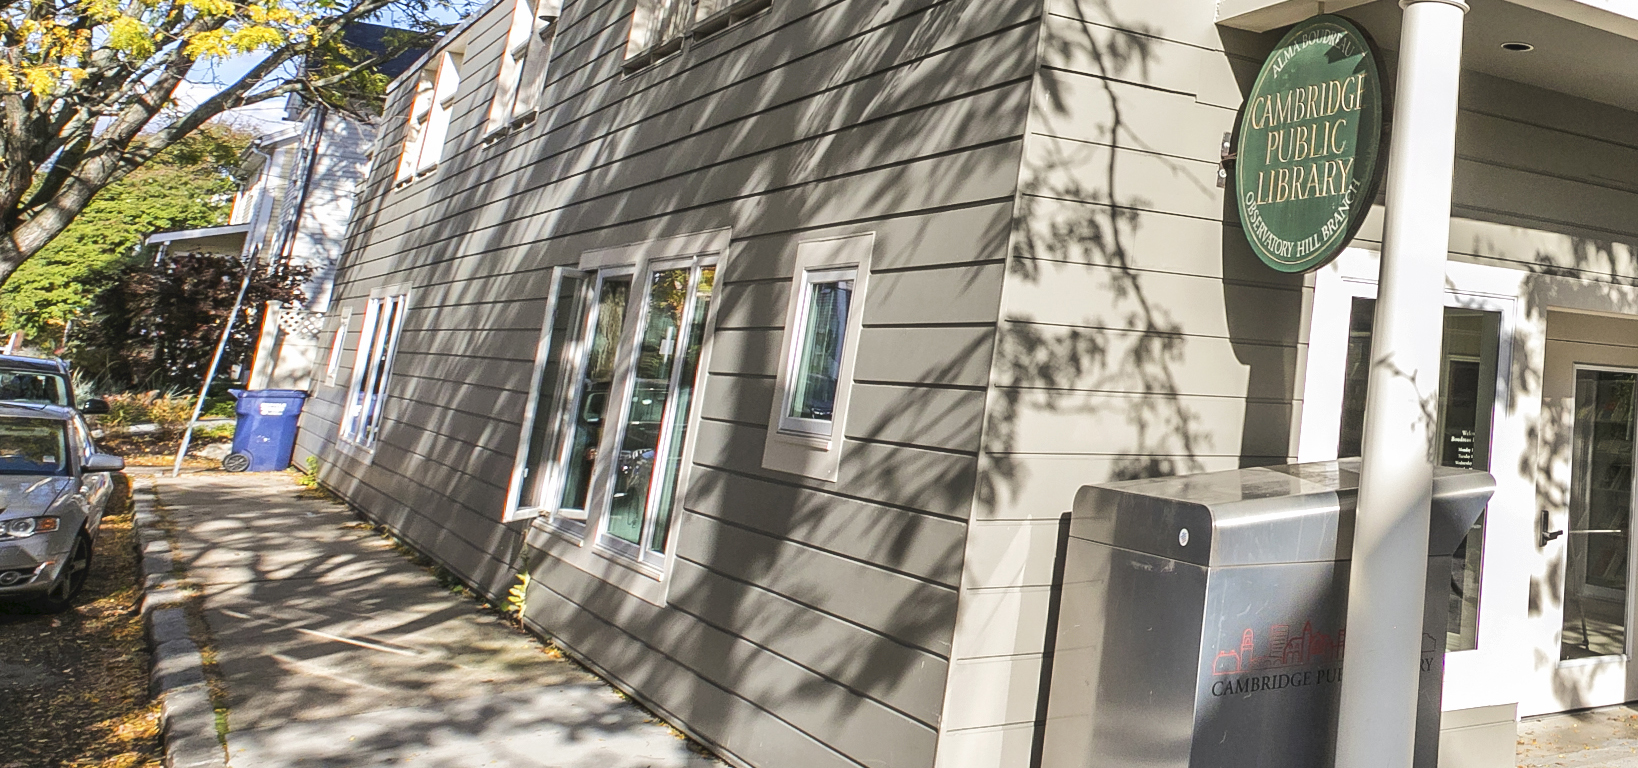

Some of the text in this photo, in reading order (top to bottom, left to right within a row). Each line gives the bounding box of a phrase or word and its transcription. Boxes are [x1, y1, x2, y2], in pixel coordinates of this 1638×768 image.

[1272, 29, 1355, 79] ALMA BOUDREAU
[1251, 72, 1367, 131] CAMBRIDGE
[1265, 119, 1347, 165] PUBLIC
[1256, 157, 1354, 205] LIBRARY
[1245, 178, 1361, 257] OBSERVATORY HILL BRANCH
[1211, 671, 1313, 697] CAMBRIDGE
